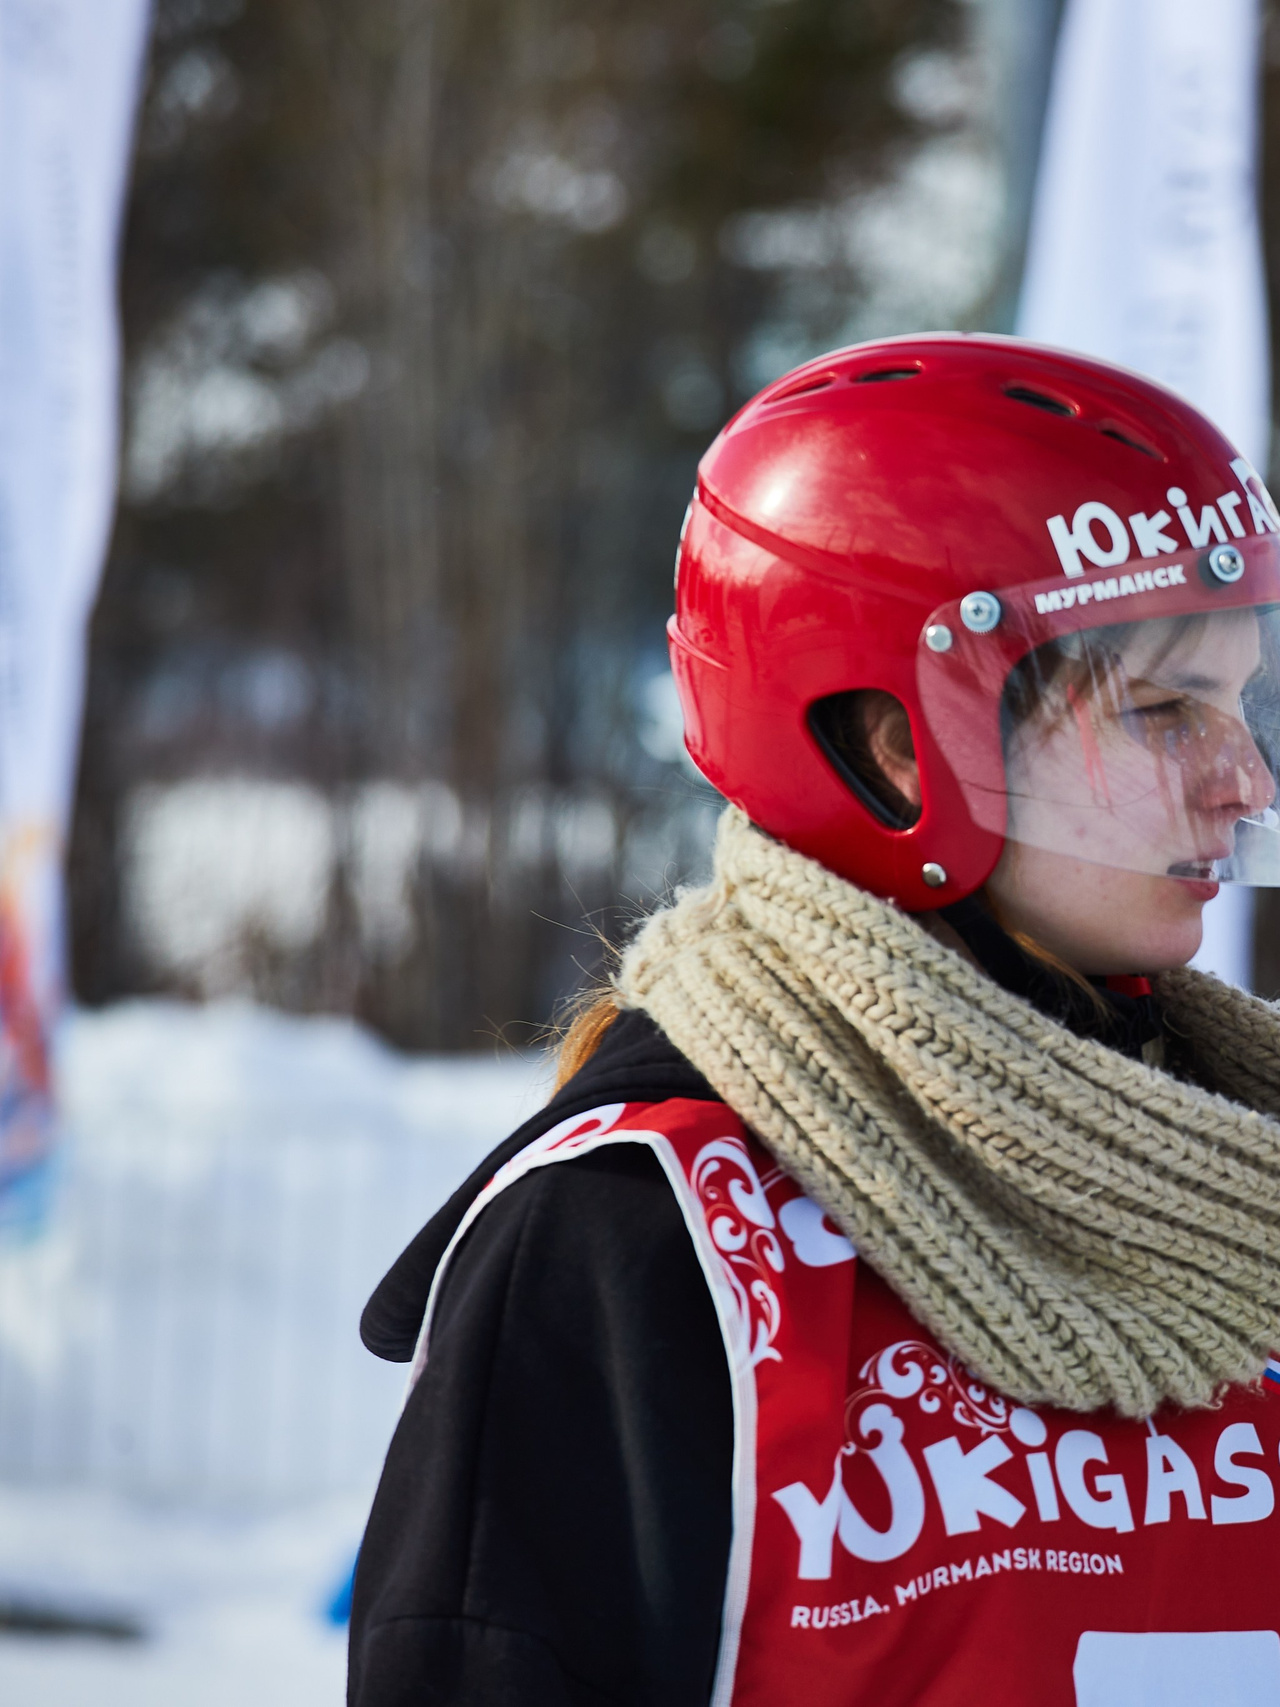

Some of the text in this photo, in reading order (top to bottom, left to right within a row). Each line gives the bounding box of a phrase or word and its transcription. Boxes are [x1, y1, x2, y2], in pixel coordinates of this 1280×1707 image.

[1034, 564, 1187, 614] МУРМАНСК
[894, 1548, 1042, 1606] MURMANSK
[1046, 1549, 1124, 1575] REGION
